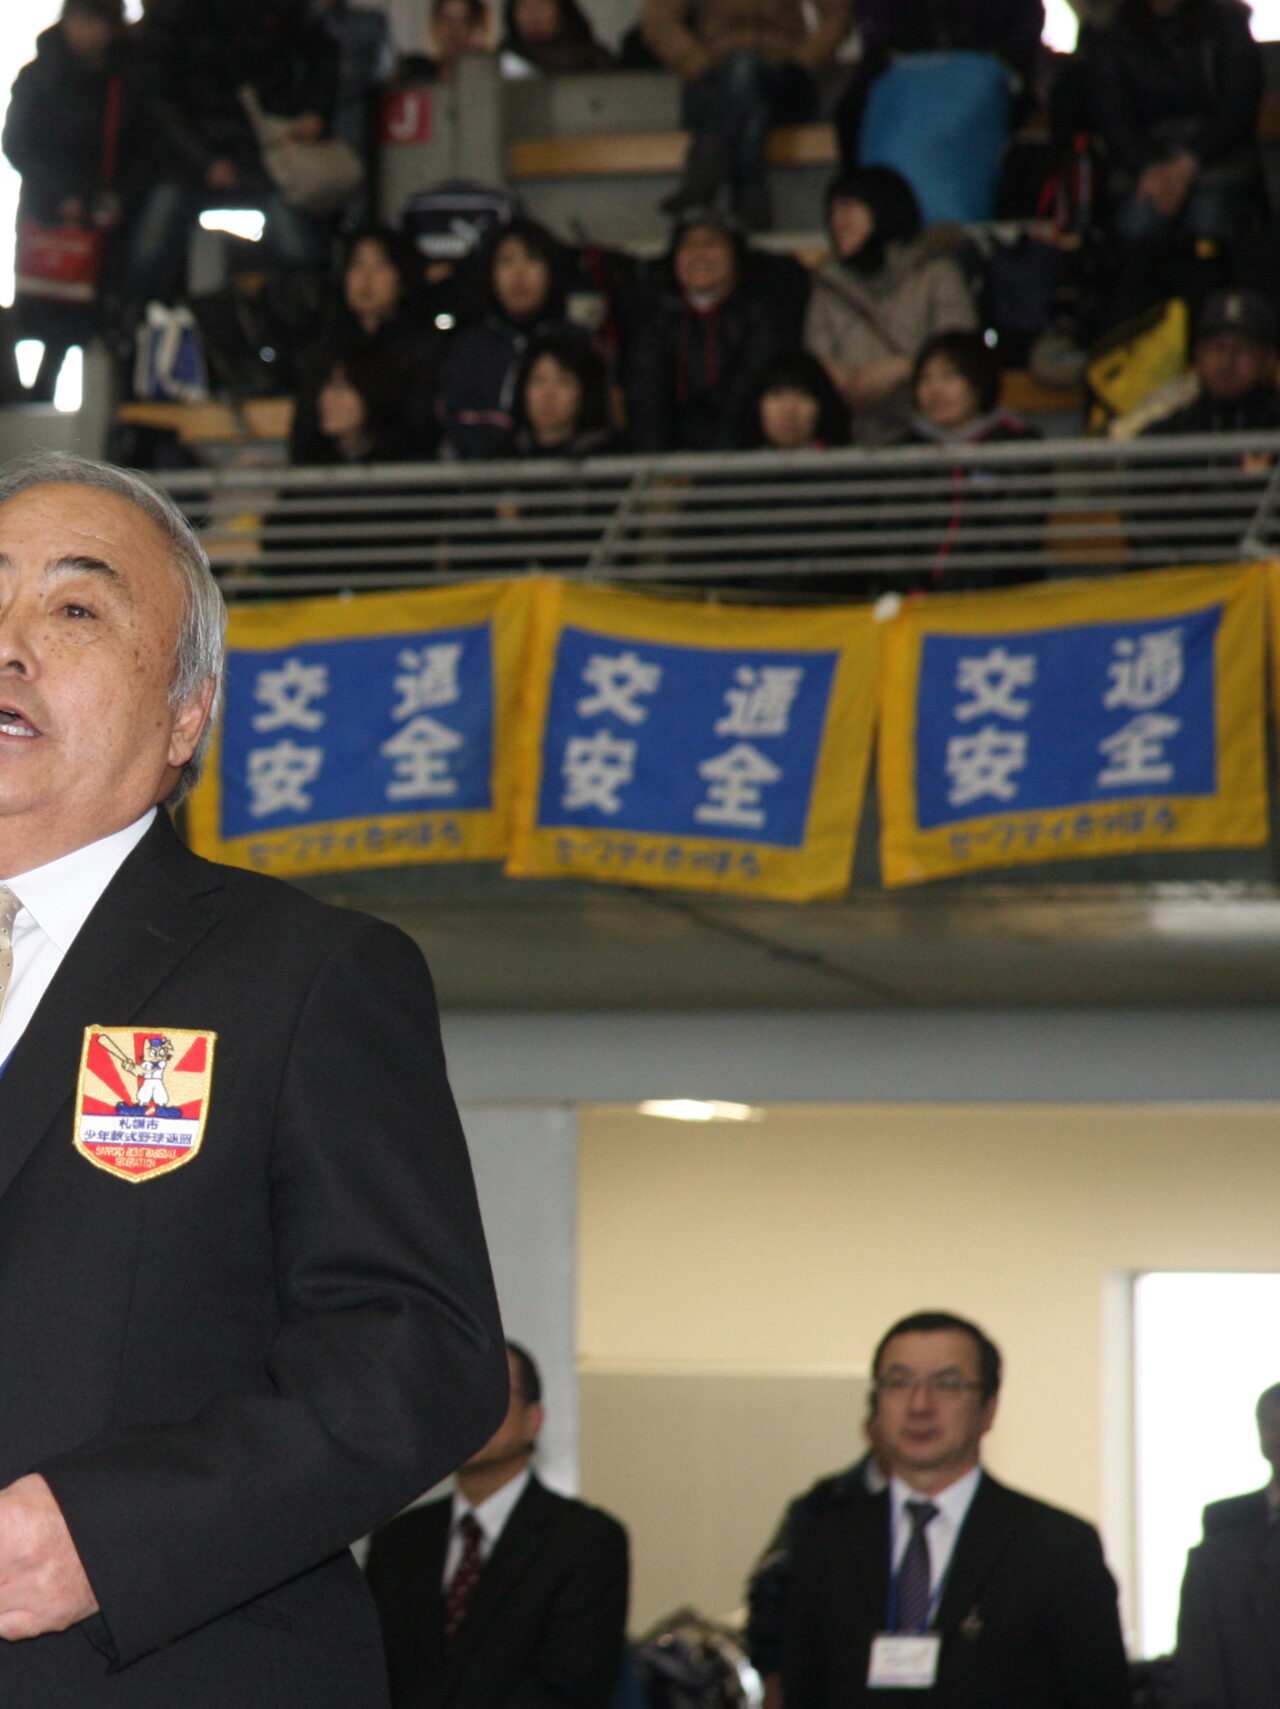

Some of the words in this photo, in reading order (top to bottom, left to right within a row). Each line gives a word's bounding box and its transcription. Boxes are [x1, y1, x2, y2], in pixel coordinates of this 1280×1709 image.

[389, 95, 417, 139] J
[119, 1118, 159, 1130] 札幌市
